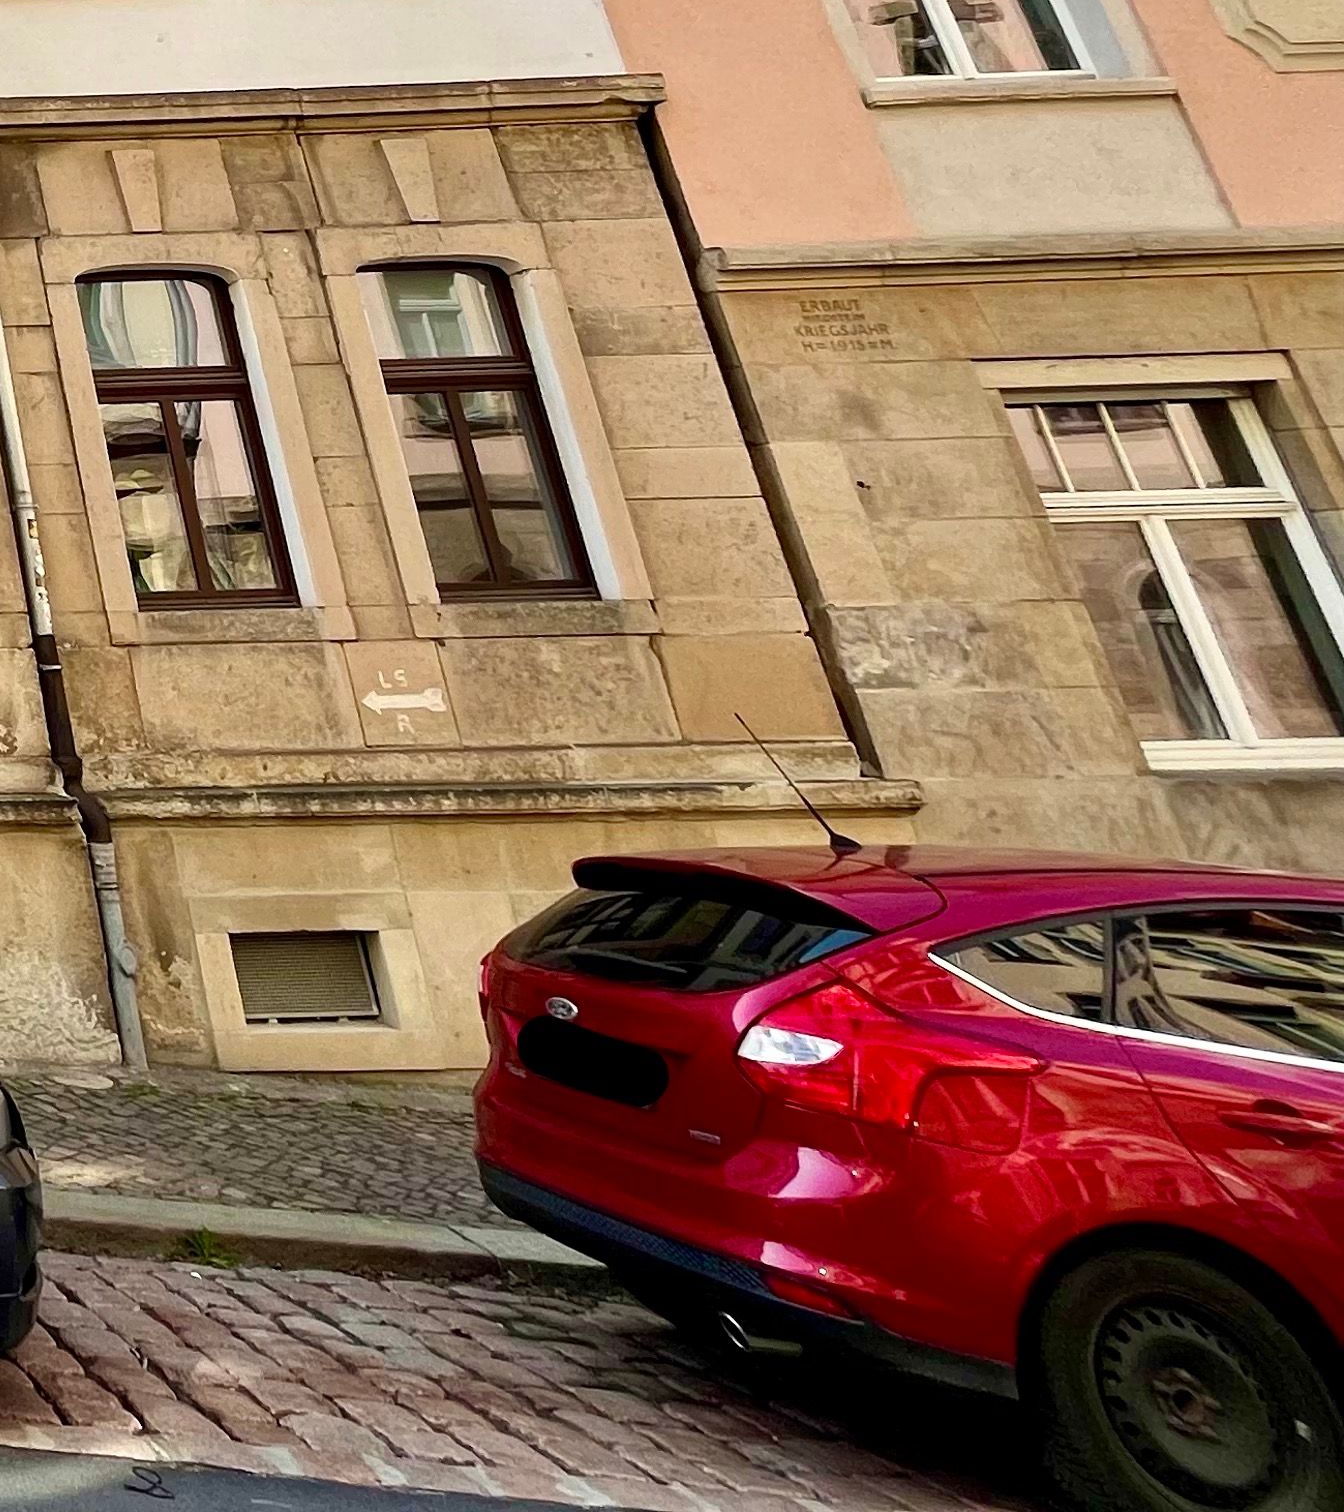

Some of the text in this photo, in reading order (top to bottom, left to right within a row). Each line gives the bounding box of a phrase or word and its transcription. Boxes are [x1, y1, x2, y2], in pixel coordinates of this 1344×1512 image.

[799, 299, 860, 313] ERBAUT
[793, 323, 892, 337] KRIEGSJAHR
[378, 669, 408, 689] LS
